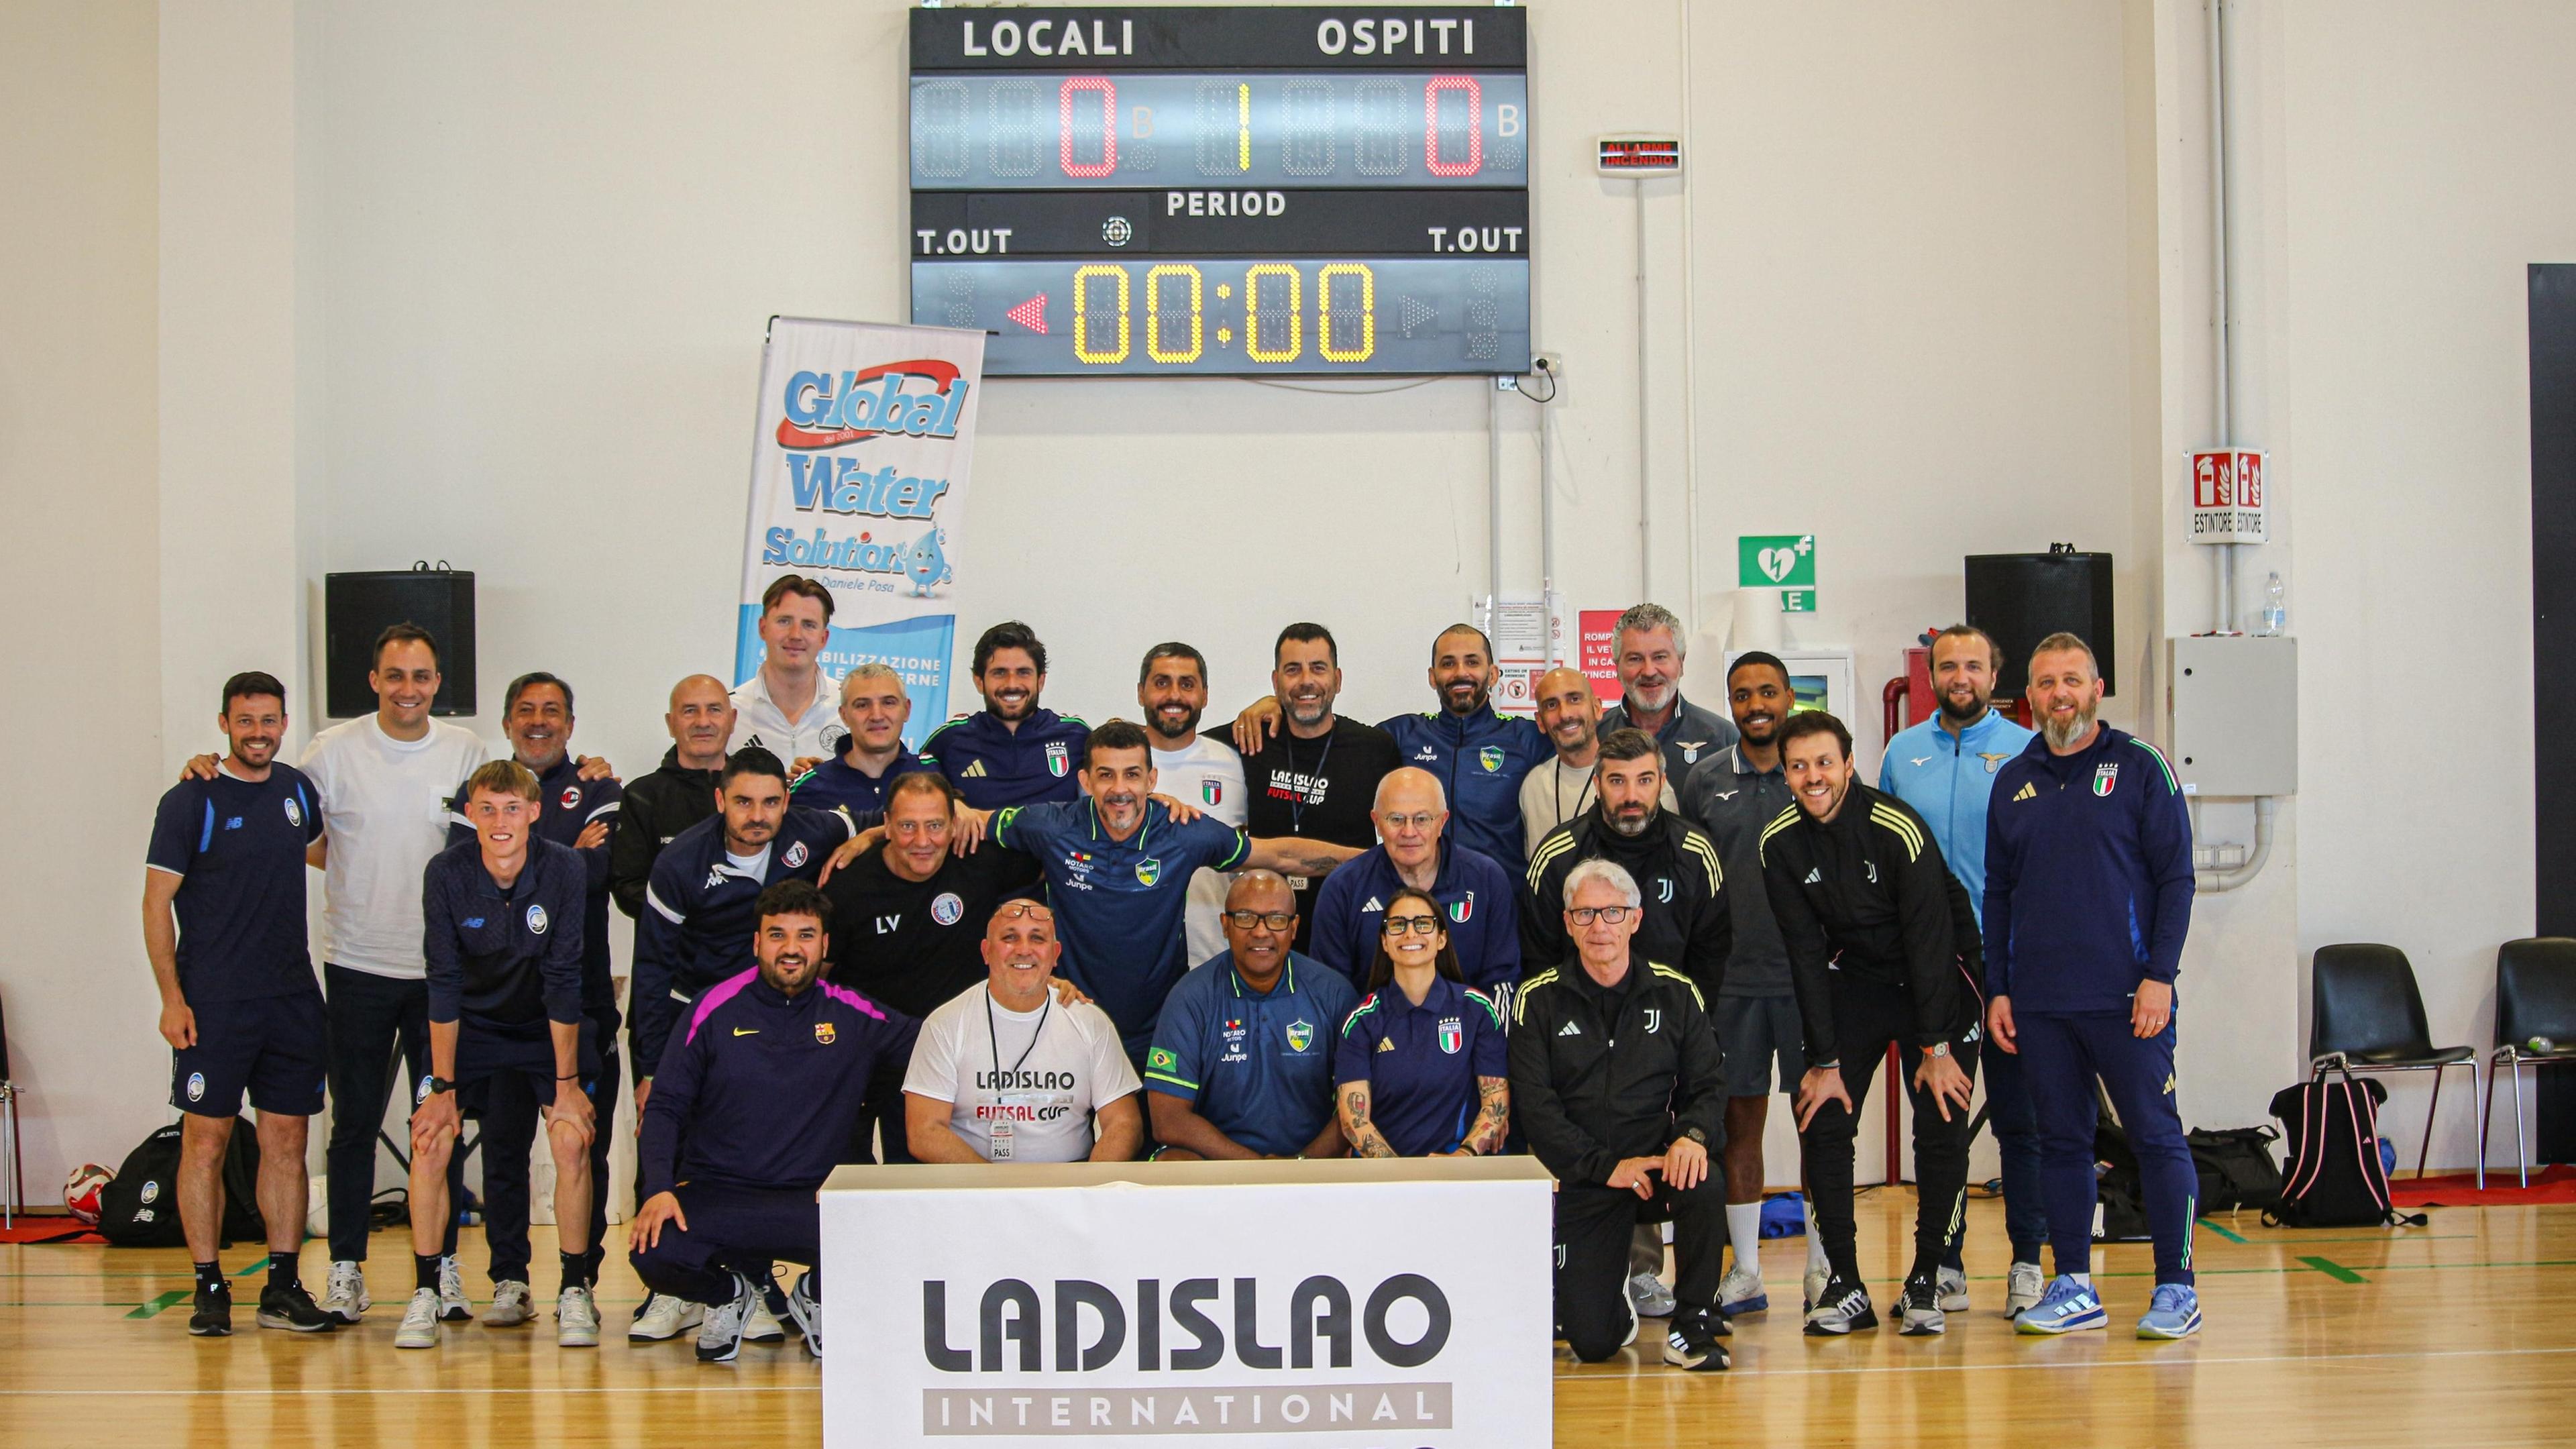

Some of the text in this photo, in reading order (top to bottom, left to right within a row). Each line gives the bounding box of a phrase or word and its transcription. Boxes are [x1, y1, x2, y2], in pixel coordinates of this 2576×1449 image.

[963, 19, 1134, 56] LOCALI
[1317, 18, 1474, 55] OSPITI
[1059, 76, 1116, 178] 0
[1239, 83, 1250, 172] 1
[1426, 76, 1482, 177] 0
[1498, 104, 1519, 137] B
[1607, 143, 1672, 152] ALLARME
[1606, 156, 1673, 166] INCENDIO
[1167, 192, 1286, 217] PERIOD
[917, 229, 1012, 254] T.OUT
[1428, 227, 1522, 252] T.OUT
[1073, 263, 1374, 364] 00:00
[784, 370, 970, 437] Global
[786, 453, 951, 521] Water
[2194, 512, 2232, 533] ESTINTORE
[2237, 512, 2261, 534] ESTINTORE
[821, 576, 864, 590] Daniele
[867, 580, 894, 593] Posa
[1584, 633, 1614, 641] ROMP
[1586, 646, 1595, 654] IL
[816, 651, 941, 671] BILIZZAZIONE
[1589, 658, 1598, 666] IN
[1414, 753, 1438, 762] Junpe
[1065, 859, 1094, 870] NOTARO
[1065, 879, 1093, 891] Junpe
[875, 914, 901, 934] LV
[1221, 1053, 1248, 1063] Junpe
[976, 1071, 1075, 1090] LADISLAO
[976, 1106, 1070, 1122] FUTSAL CUP
[994, 1148, 1010, 1157] PASS
[922, 1273, 1452, 1373] LADISLAO
[941, 1391, 1435, 1427] INTERNATIONAL
